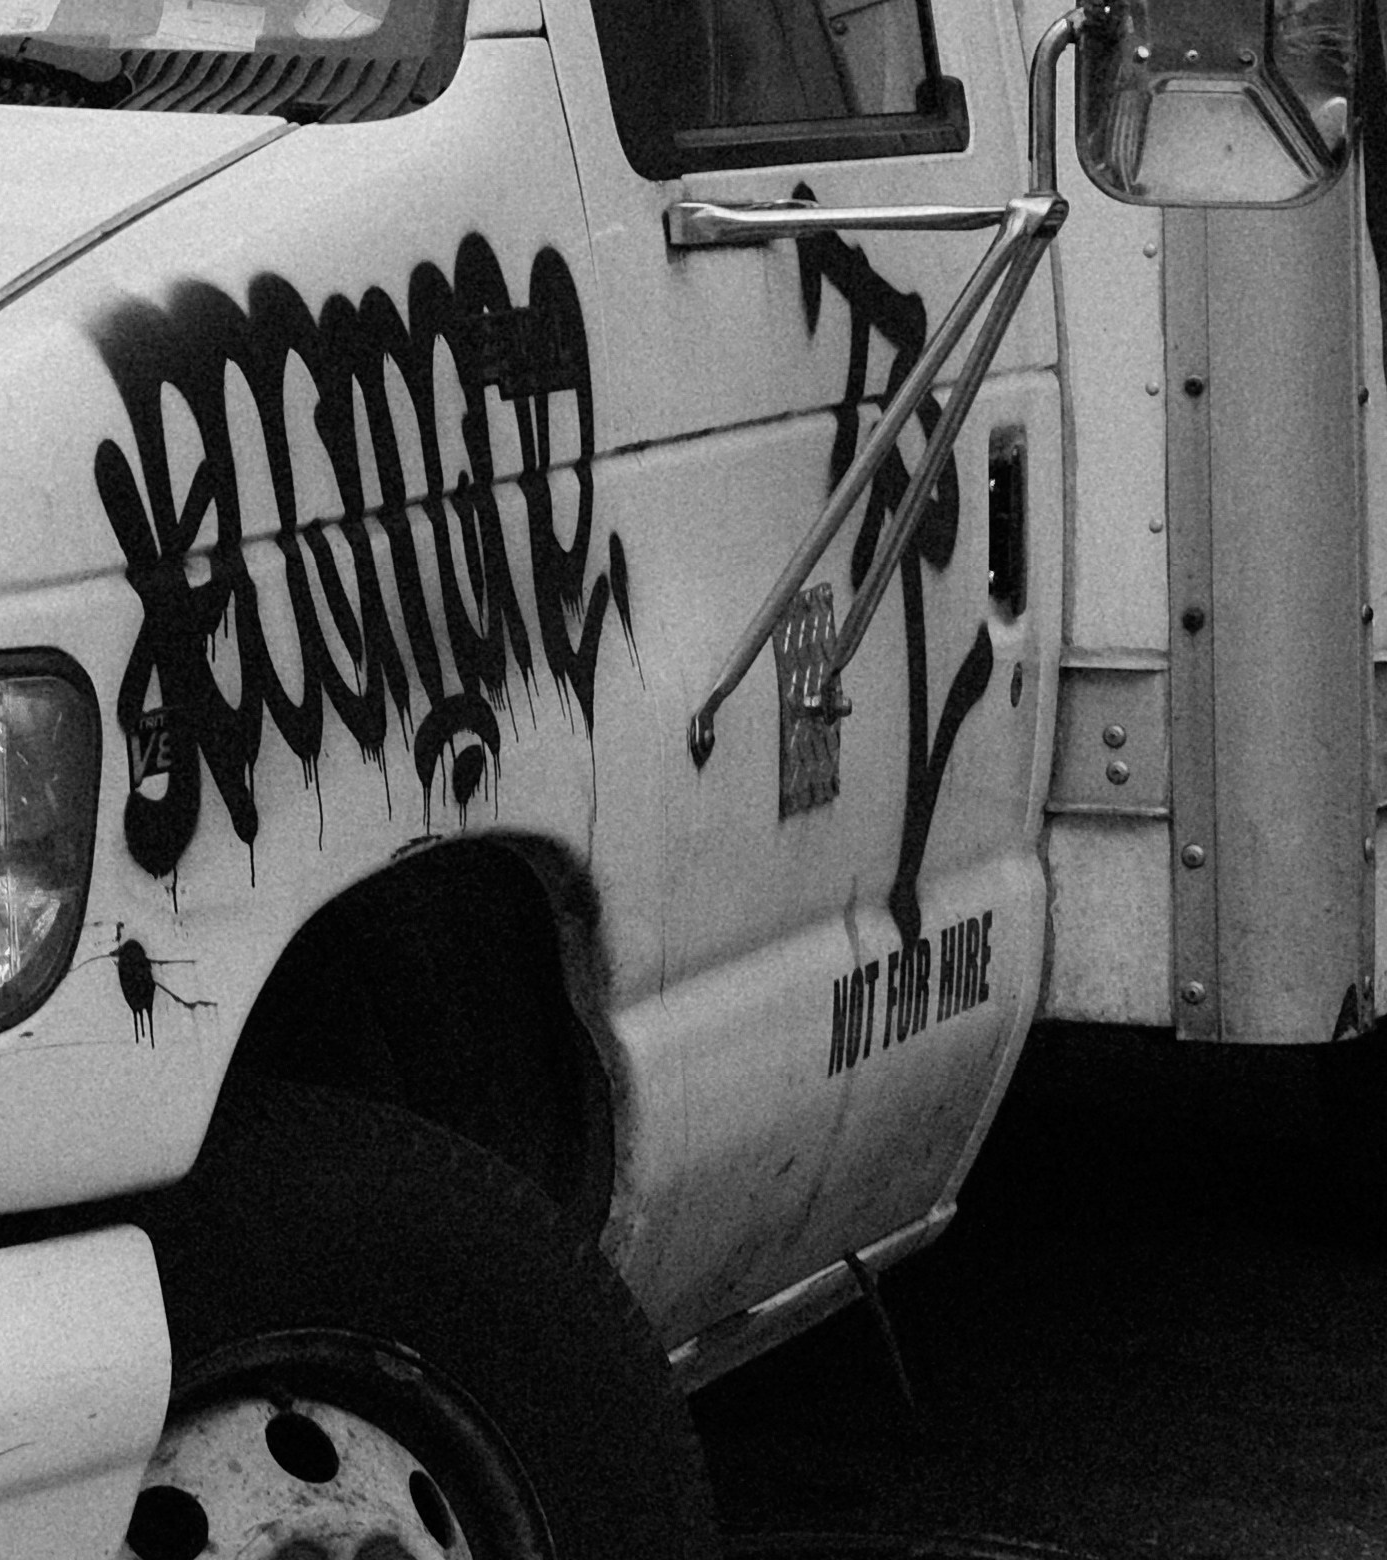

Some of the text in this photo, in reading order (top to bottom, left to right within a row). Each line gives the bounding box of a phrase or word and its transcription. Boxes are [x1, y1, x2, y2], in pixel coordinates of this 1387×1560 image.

[829, 910, 995, 1076] NOT FOR HIRE
